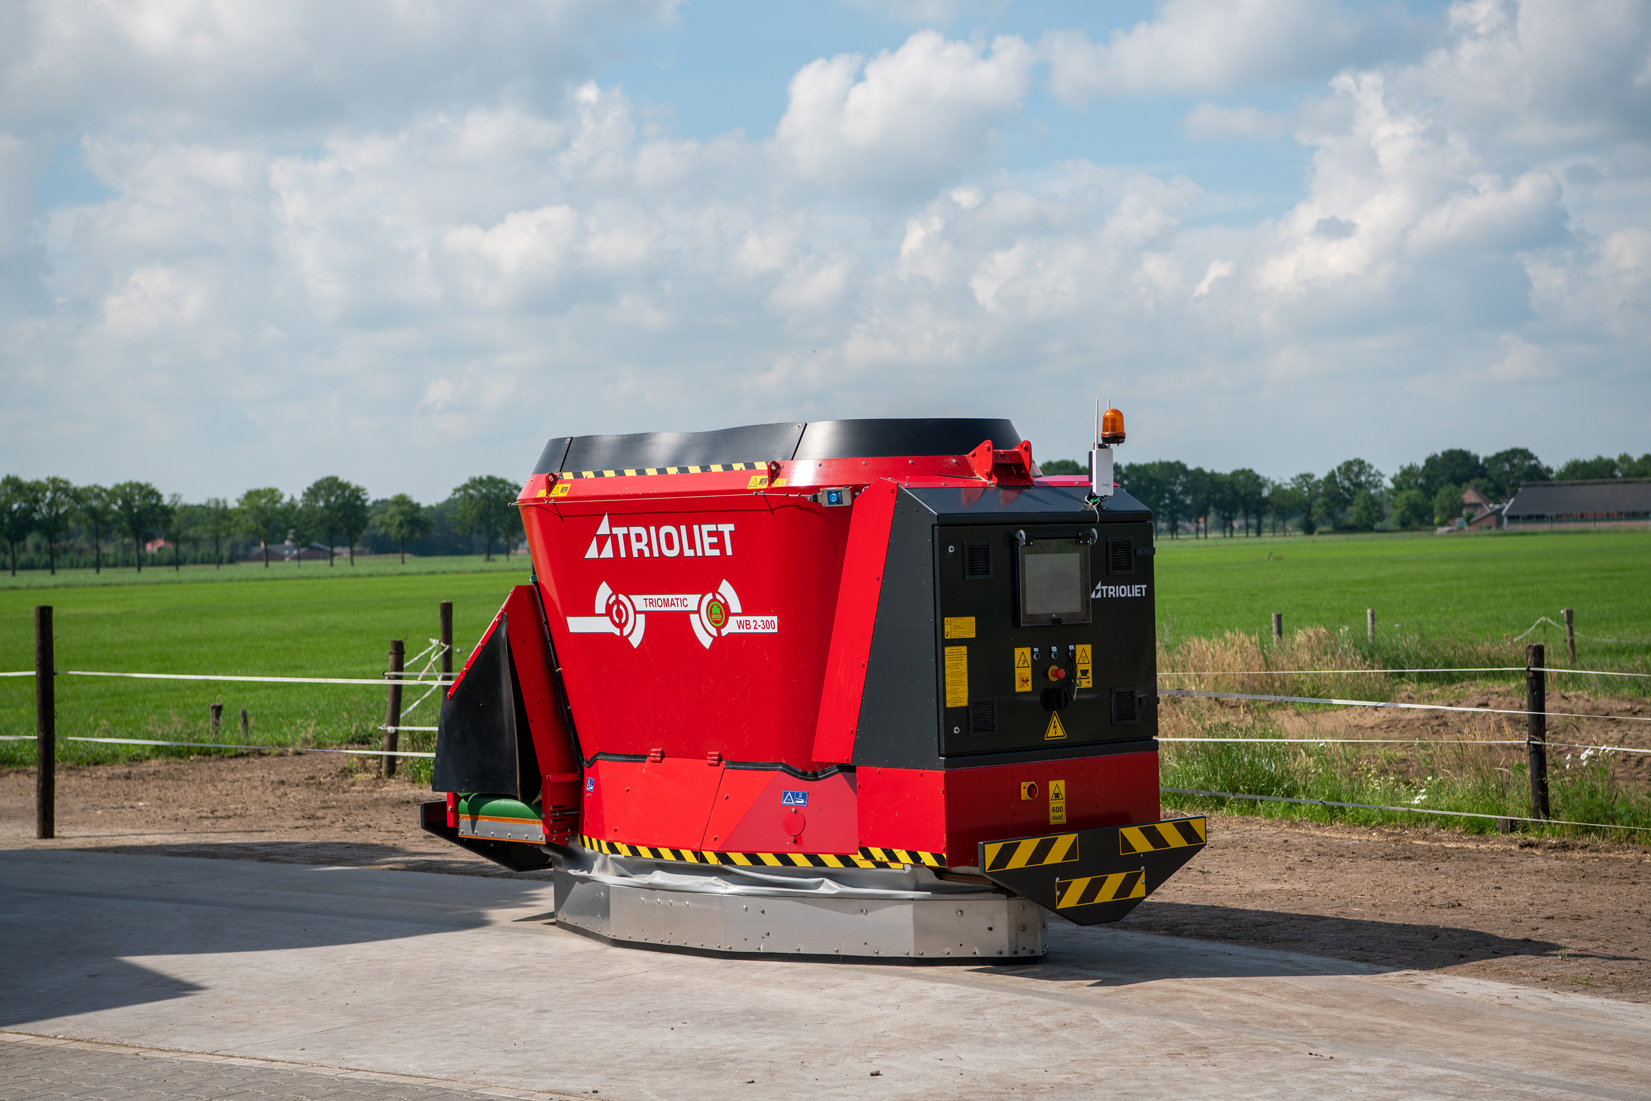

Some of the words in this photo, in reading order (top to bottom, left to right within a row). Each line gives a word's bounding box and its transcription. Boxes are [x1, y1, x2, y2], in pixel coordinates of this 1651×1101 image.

[611, 523, 735, 558] TRIOLIET
[1101, 584, 1147, 598] TRIOLIET
[643, 597, 688, 608] TRIOMATIC
[736, 620, 751, 630] WB
[753, 619, 775, 630] 2-300
